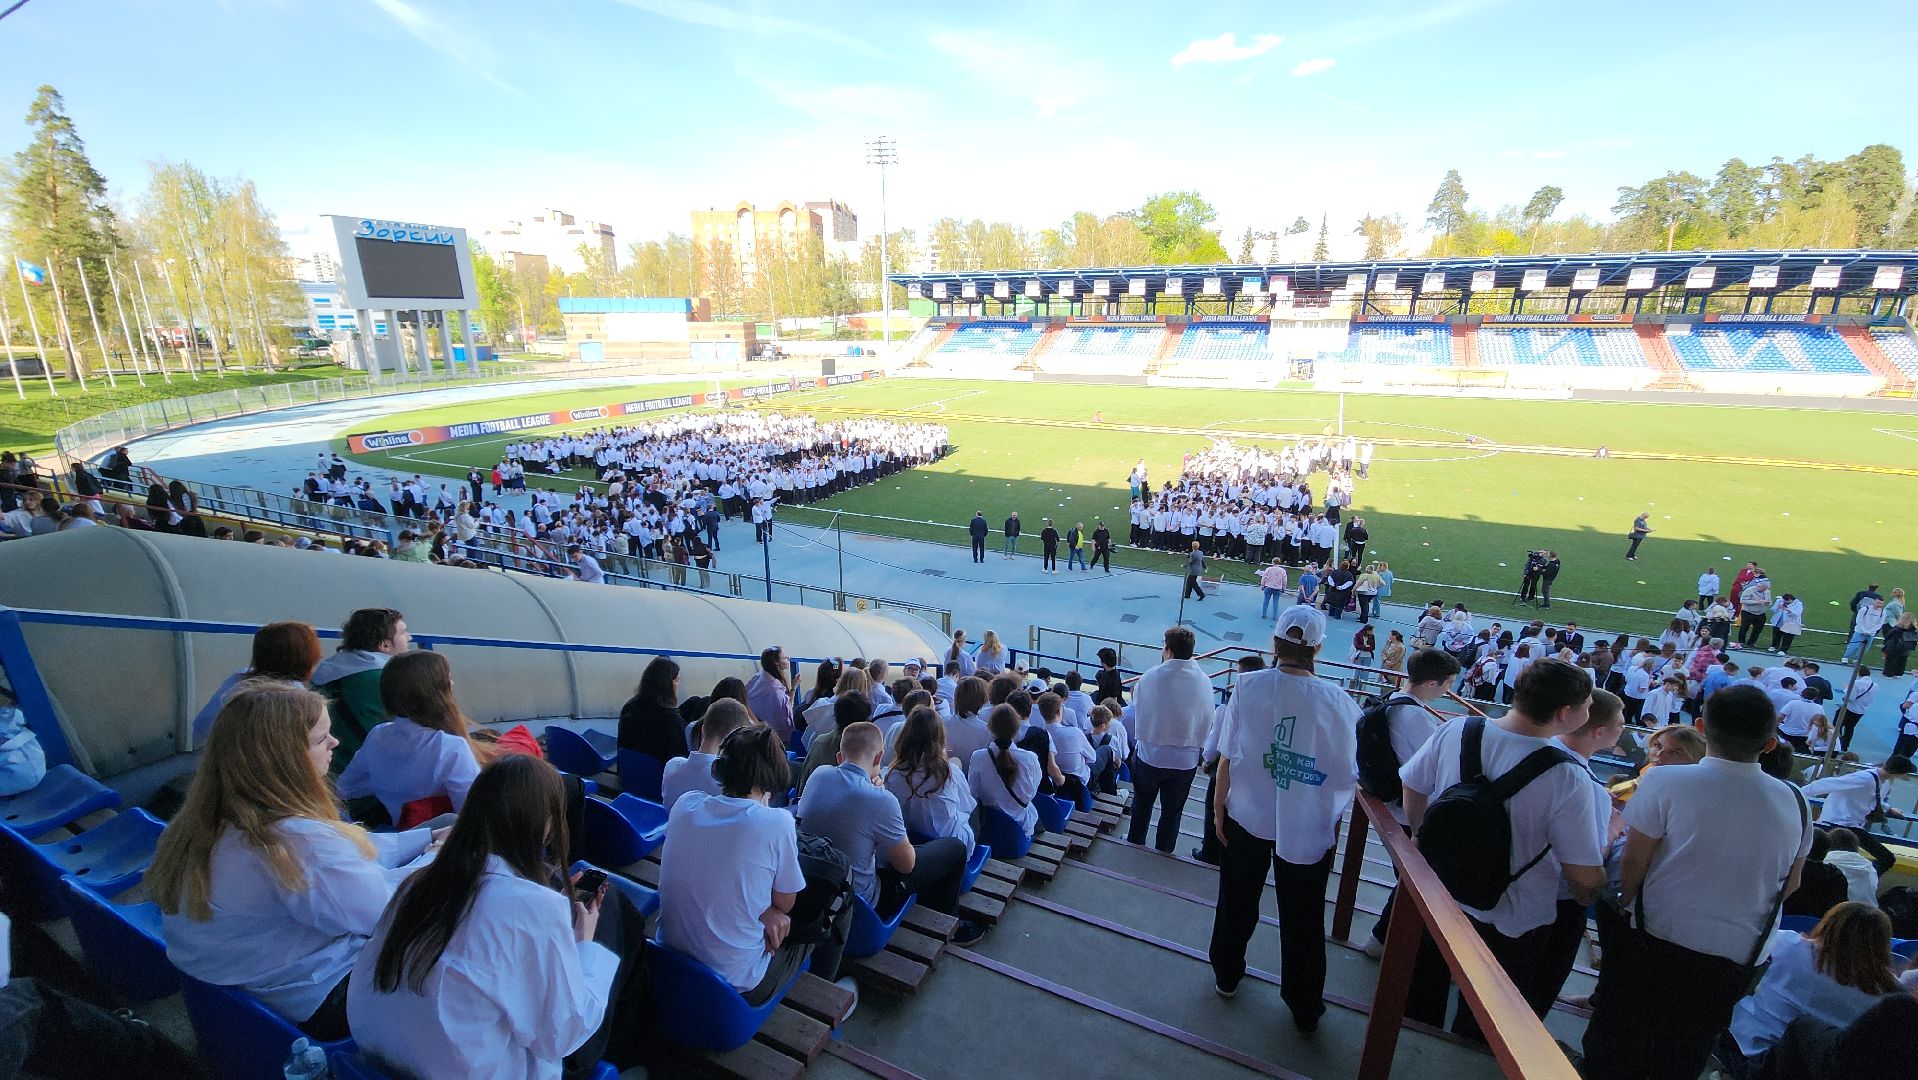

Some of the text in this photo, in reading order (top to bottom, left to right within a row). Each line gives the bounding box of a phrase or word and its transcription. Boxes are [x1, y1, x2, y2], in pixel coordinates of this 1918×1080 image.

[1718, 314, 1808, 322] MEDIA FOOTBALL LEAGUE
[625, 395, 692, 413] MEDIA FOOTBALL LEAGUE
[573, 410, 599, 420] Winline
[450, 414, 551, 438] MEDIA FOOTBALL LEAGUE
[367, 432, 408, 447] Winline
